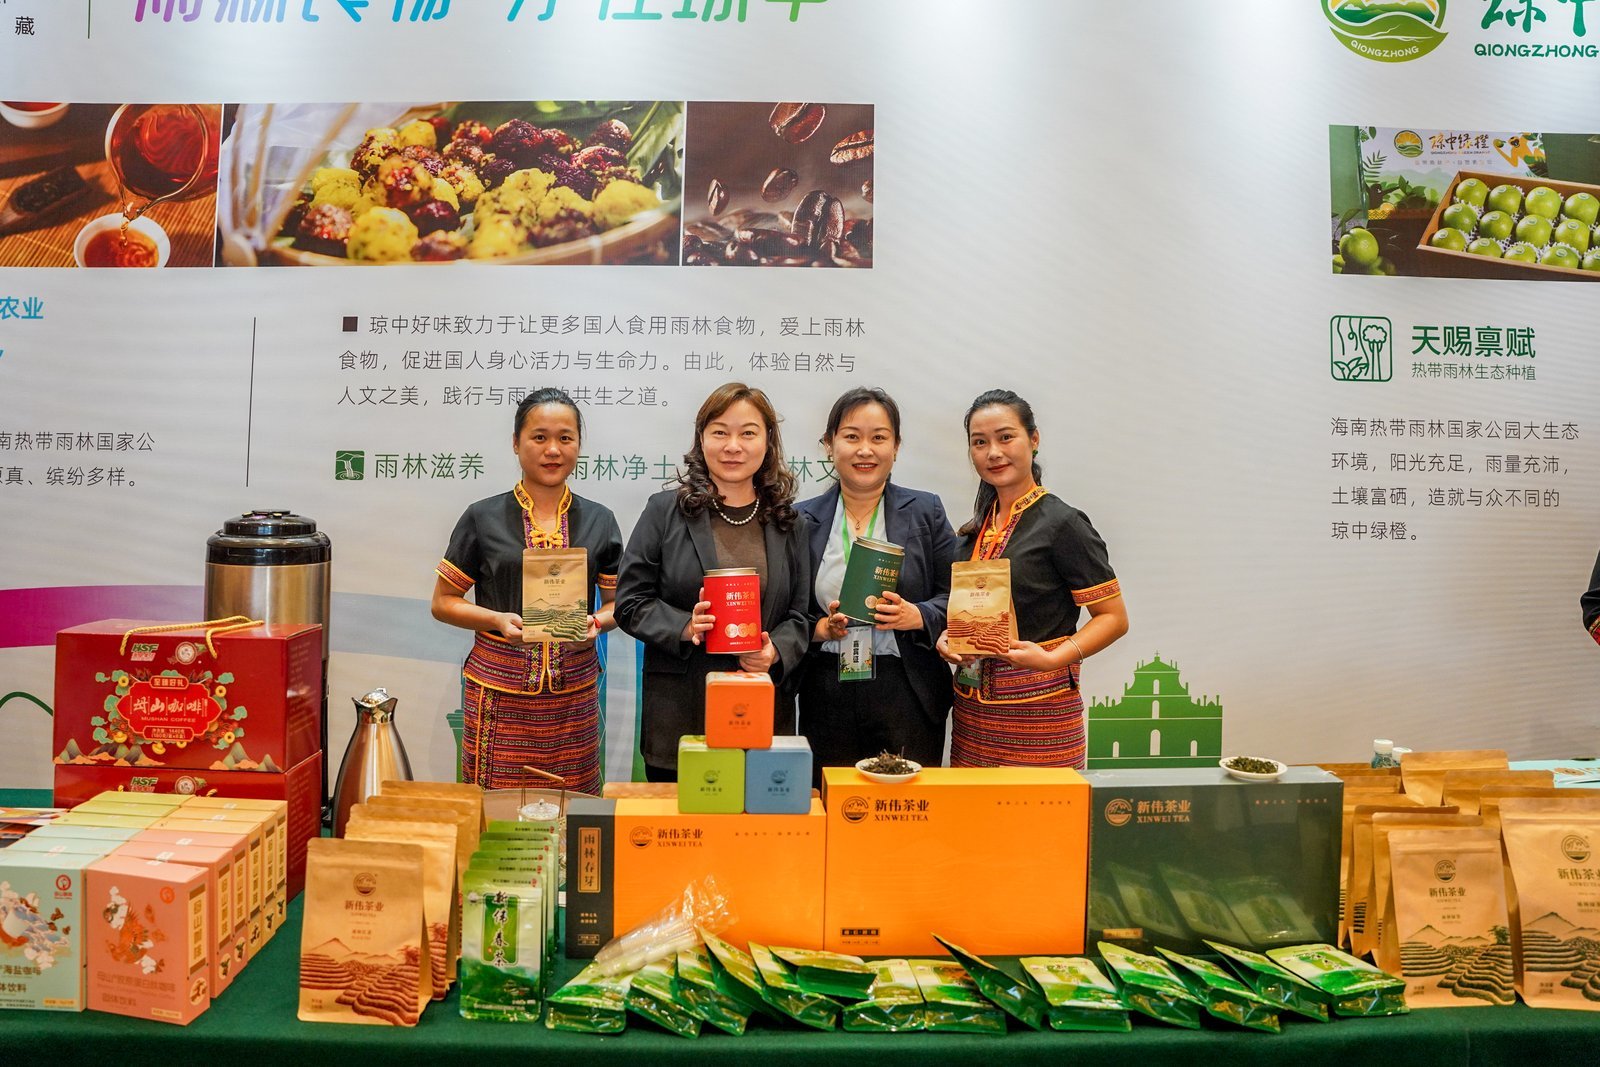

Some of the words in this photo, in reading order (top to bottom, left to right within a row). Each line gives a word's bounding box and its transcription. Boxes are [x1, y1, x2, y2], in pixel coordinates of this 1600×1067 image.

[15, 16, 35, 36] 藏
[1350, 39, 1420, 58] QIONGZHONG
[1474, 43, 1600, 58] QIONGZHONG
[0, 296, 44, 320] 农业
[369, 315, 866, 338] 琼中好味致力于让更多国人食用雨林食物，爱上雨林
[1411, 325, 1536, 358] 天赐禀赋
[338, 350, 856, 373] 食物，促进国人身心活力与生命力。由此，体验自然与
[1411, 362, 1537, 381] 热带雨林生态种植
[1330, 417, 1580, 440] 海南热带雨林国家公园大生态
[0, 432, 156, 452] 南热带雨林国家公
[374, 452, 484, 480] 雨林滋养
[1330, 452, 1568, 475] 环境，阳光充足，雨量充沛，
[0, 467, 137, 487] 真、缤纷多样。
[1331, 487, 1561, 508] 土壤富硒，造就与众不同的
[1331, 521, 1418, 541] 琼中绿橙。
[132, 643, 159, 653] HSF
[875, 799, 929, 812] 新伟茶业
[1137, 800, 1191, 814] 新伟茶业
[874, 814, 909, 822] XINWEI
[911, 814, 928, 822] TEA
[1137, 815, 1171, 823] XINWEI
[1173, 815, 1190, 823] TEA
[657, 828, 703, 840] 新伟茶业
[492, 890, 508, 967] 新伟春茶
